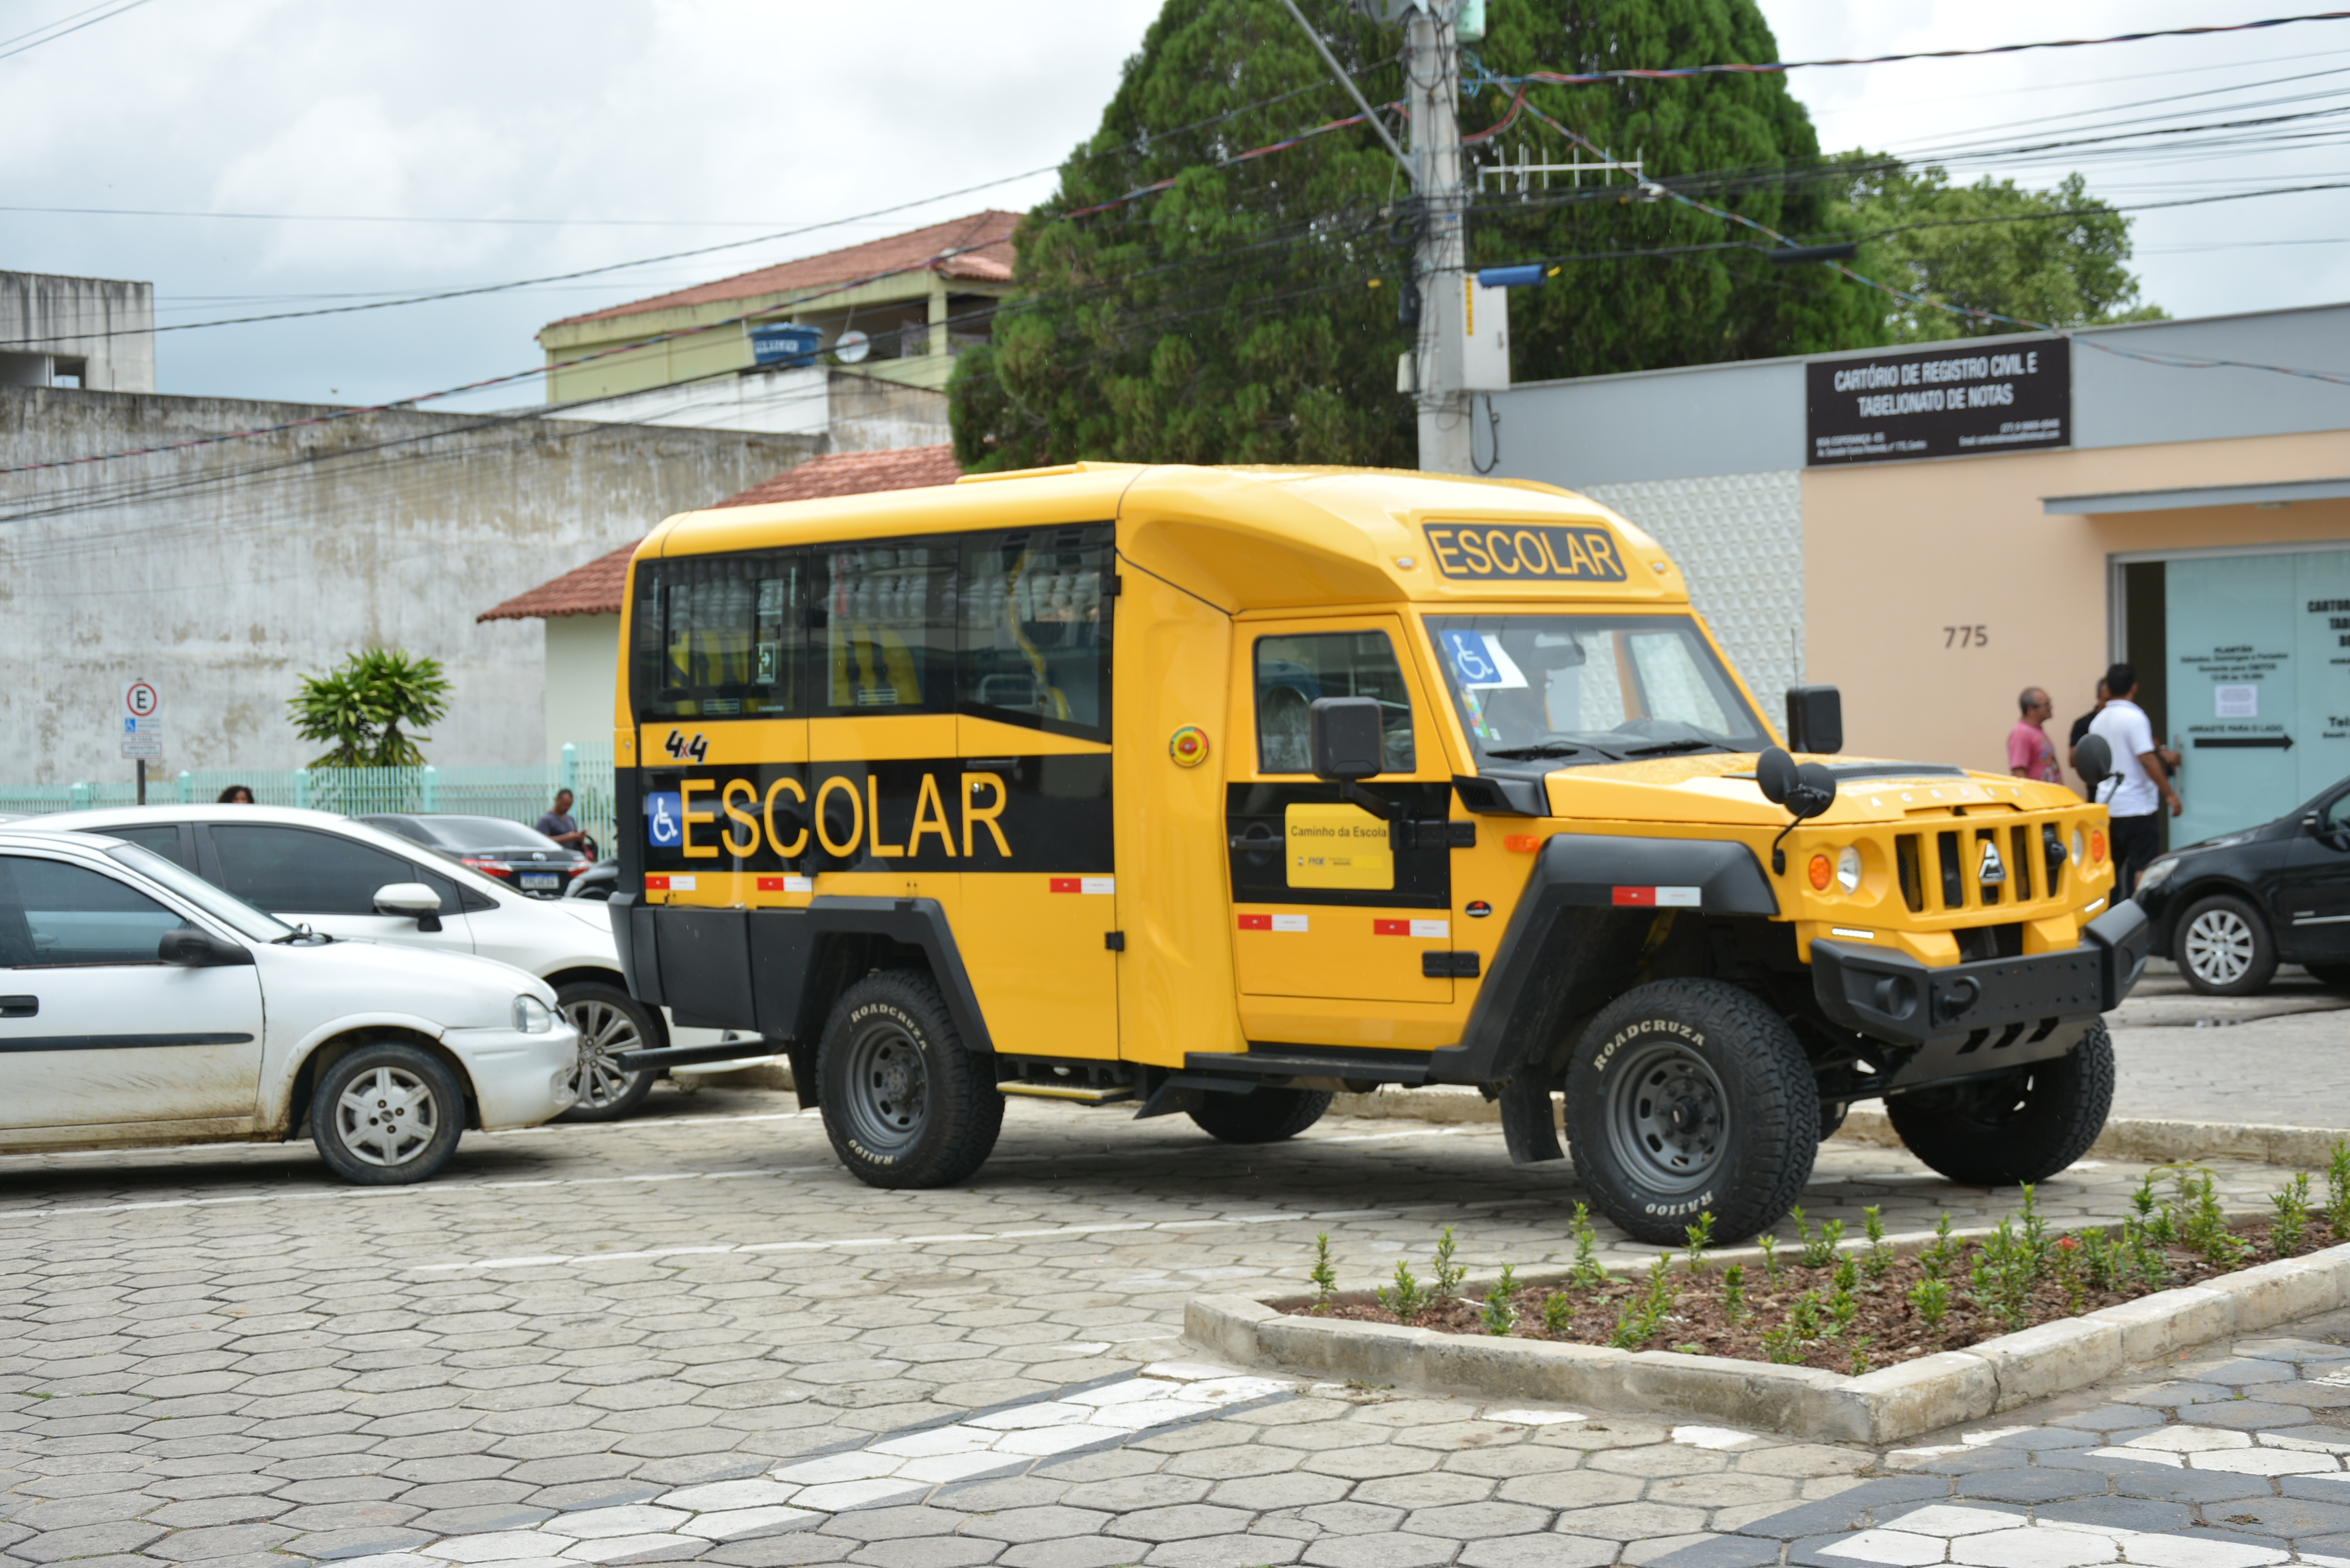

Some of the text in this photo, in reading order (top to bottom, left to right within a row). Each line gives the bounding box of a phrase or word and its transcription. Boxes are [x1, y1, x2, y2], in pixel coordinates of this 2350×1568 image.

[1834, 351, 2038, 392] CARTÓRIO DE REGISTRO CIVIL E
[1857, 383, 2014, 418] TABELIONATO DE NOTAS
[1427, 529, 1623, 577] ESCOLAR
[1943, 624, 1988, 649] 775
[136, 690, 146, 709] E
[665, 729, 709, 764] 4x4
[680, 772, 1013, 859] ESCOLAR
[1291, 825, 1387, 837] Caminho da Escola
[851, 1004, 927, 1051] ROADCRUZA
[1594, 1020, 1706, 1071] ROADCRUZA
